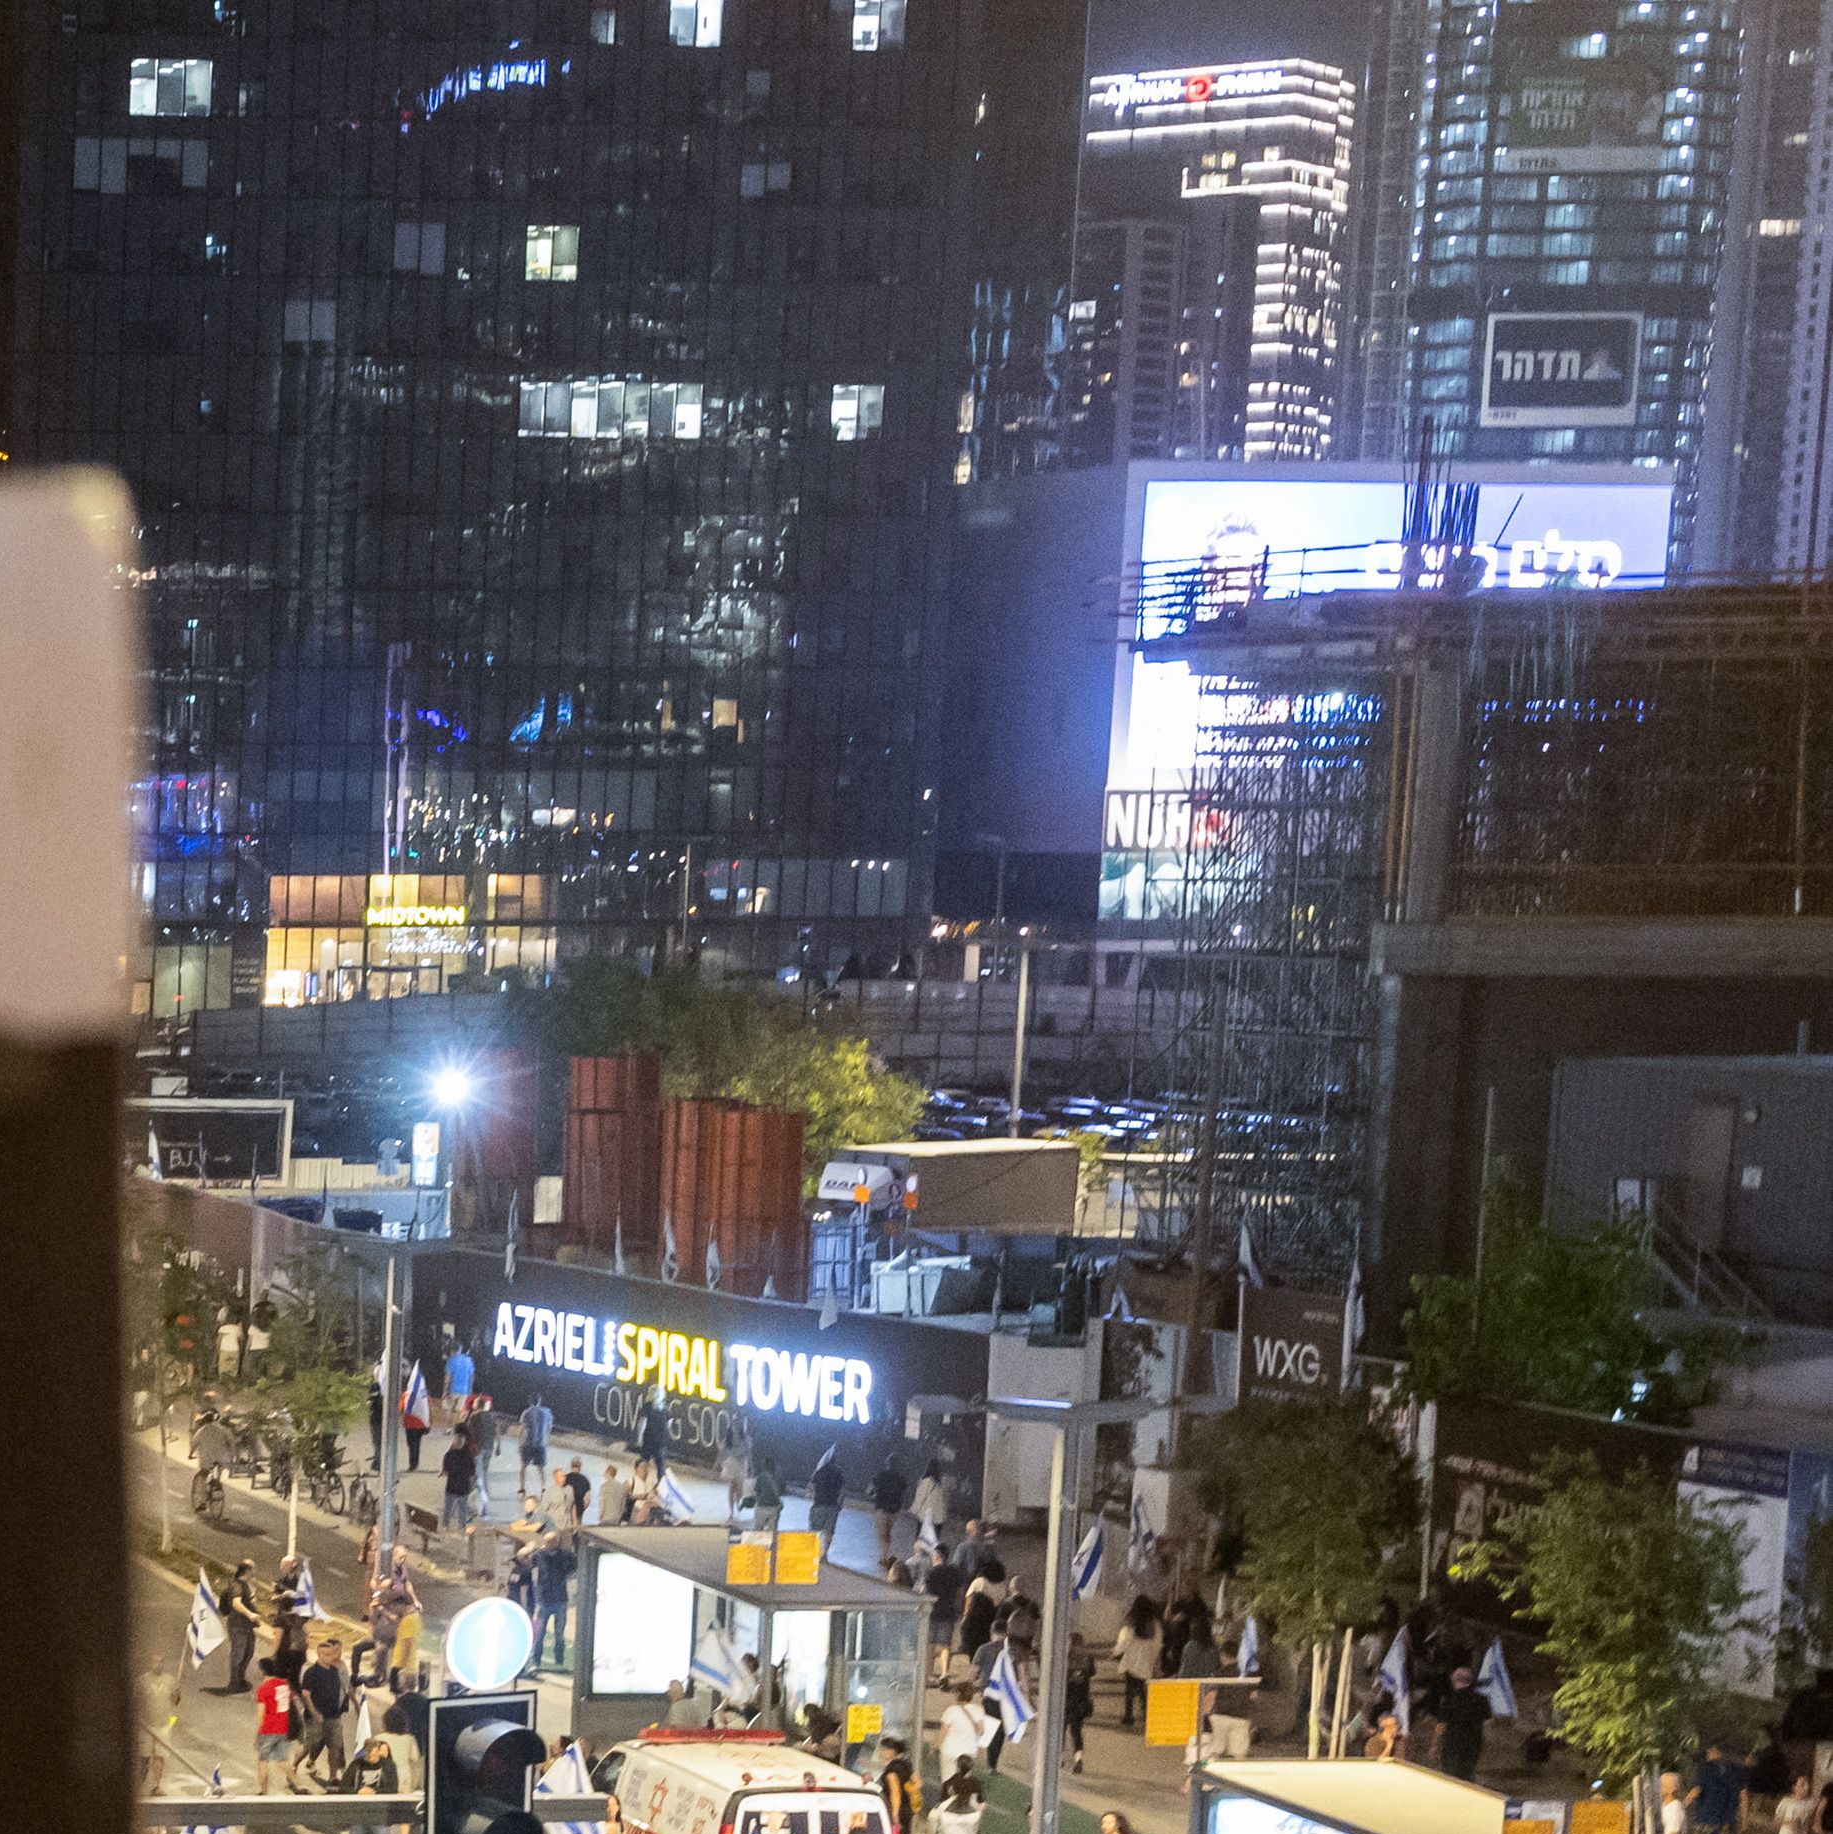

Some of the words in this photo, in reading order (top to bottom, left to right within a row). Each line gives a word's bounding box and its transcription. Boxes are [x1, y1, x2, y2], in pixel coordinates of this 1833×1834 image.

[1495, 350, 1581, 381] תדהר
[366, 905, 466, 926] MIDTOWN
[615, 1322, 727, 1402] SPIRAL
[729, 1343, 873, 1426] TOWER
[594, 1383, 682, 1440] COMG
